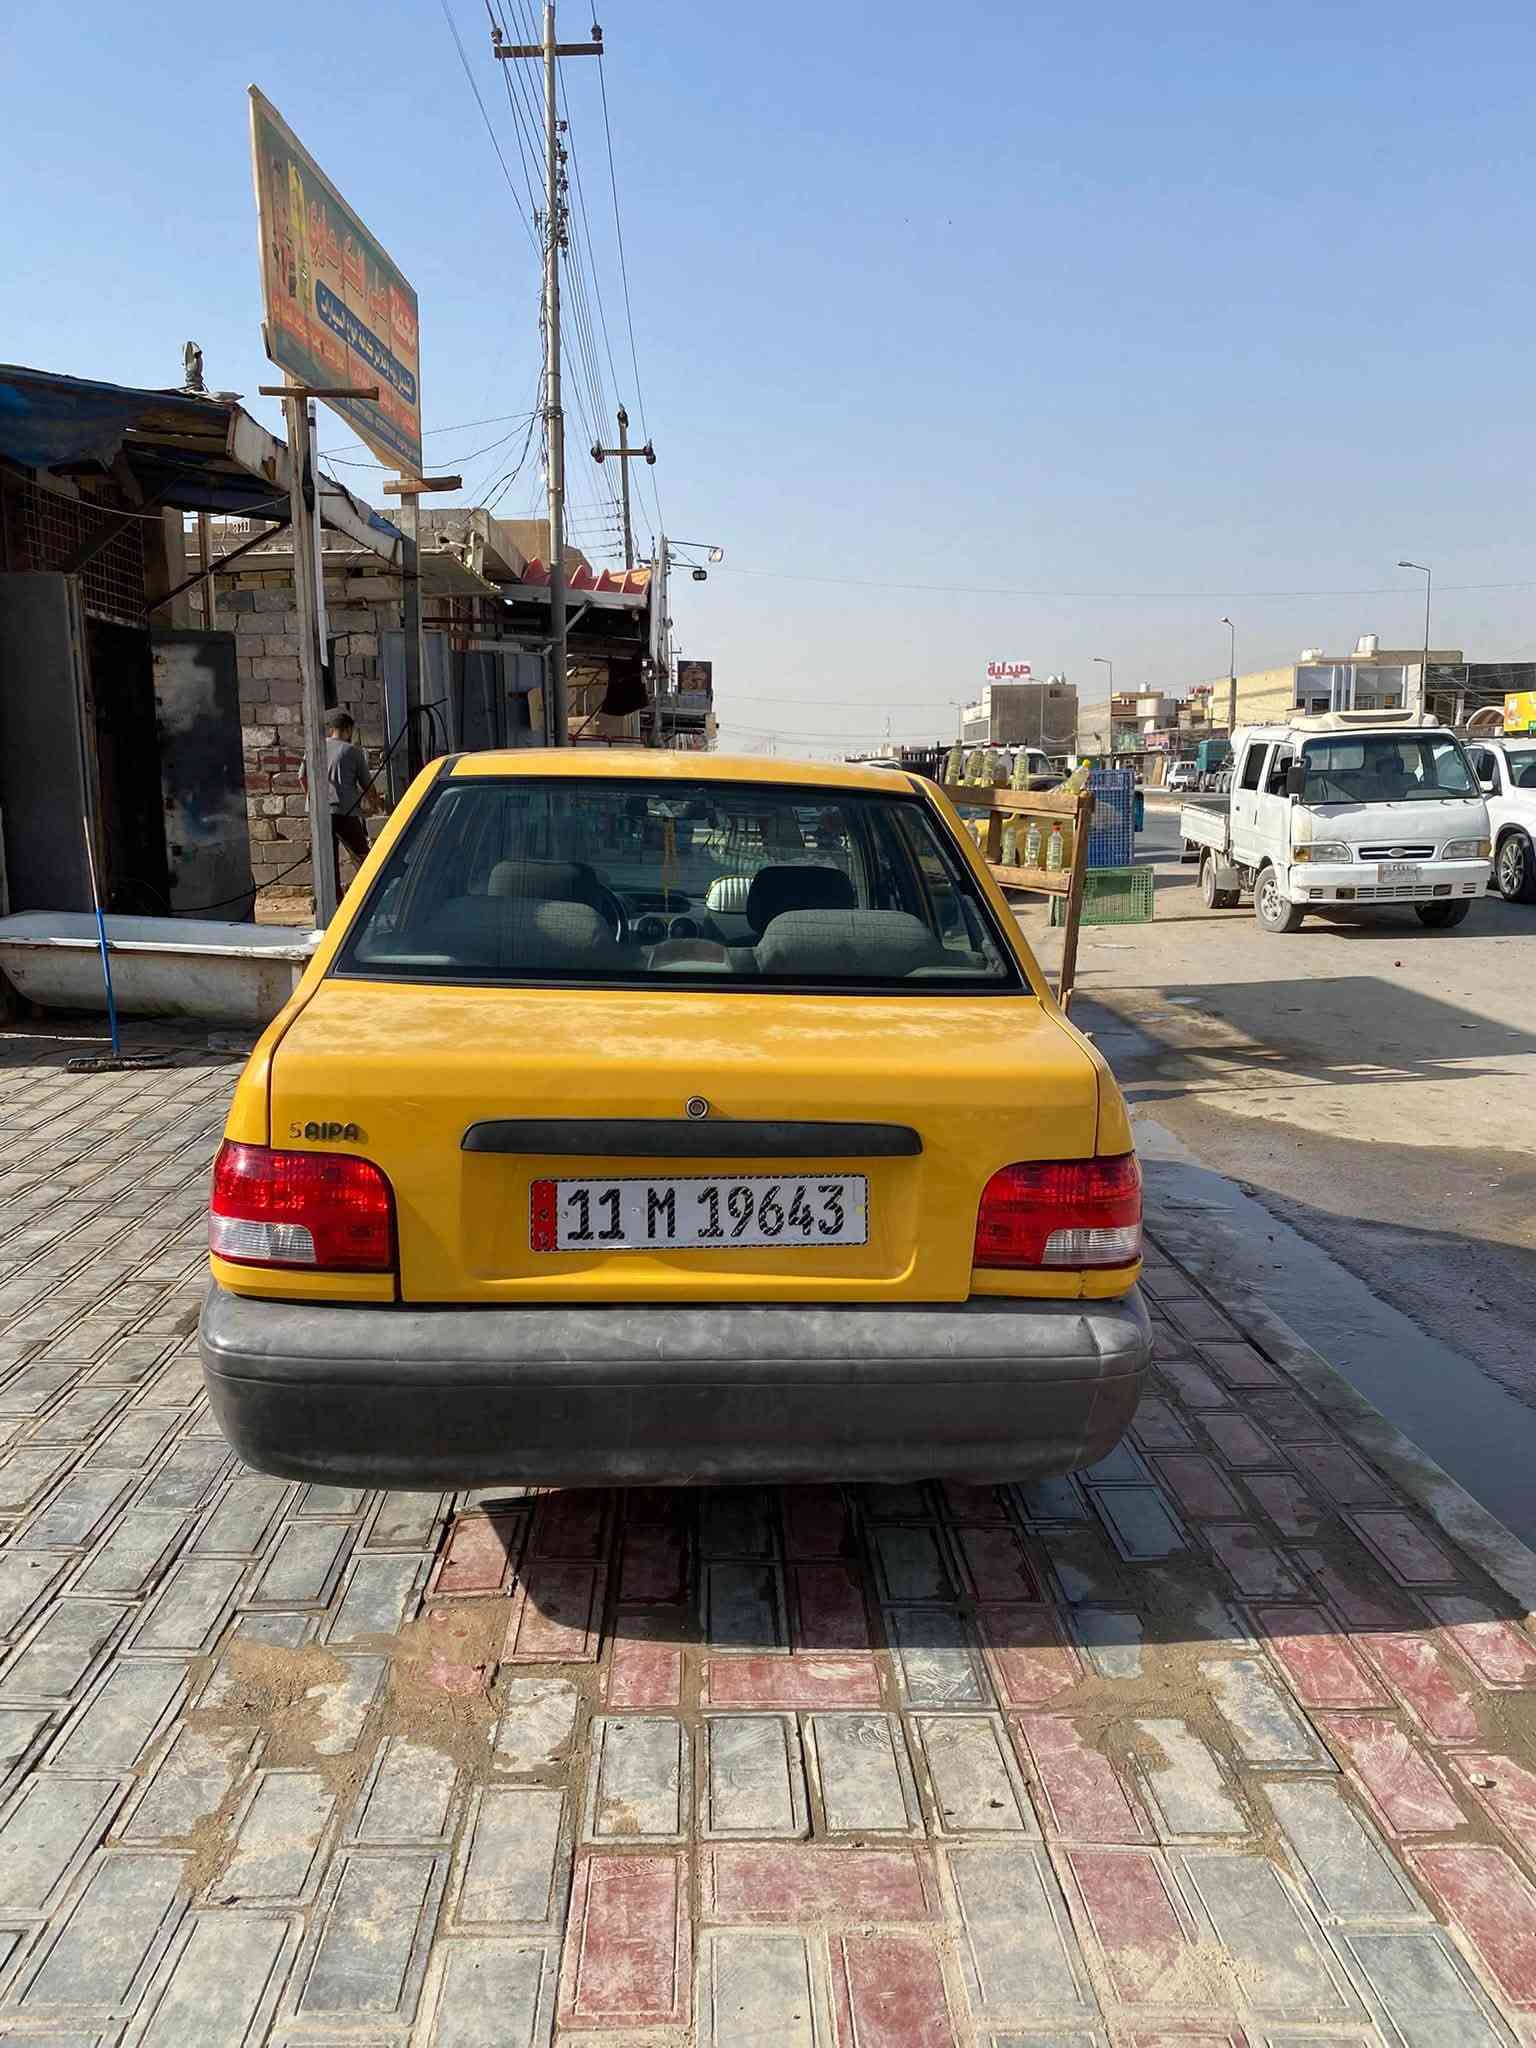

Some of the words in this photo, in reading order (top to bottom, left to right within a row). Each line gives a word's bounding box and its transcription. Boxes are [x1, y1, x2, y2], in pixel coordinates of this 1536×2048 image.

[987, 662, 1031, 679] صيدلية
[289, 1120, 360, 1140] SAIPA
[567, 1188, 625, 1240] 11
[647, 1186, 676, 1239] M
[697, 1184, 846, 1238] 19643
